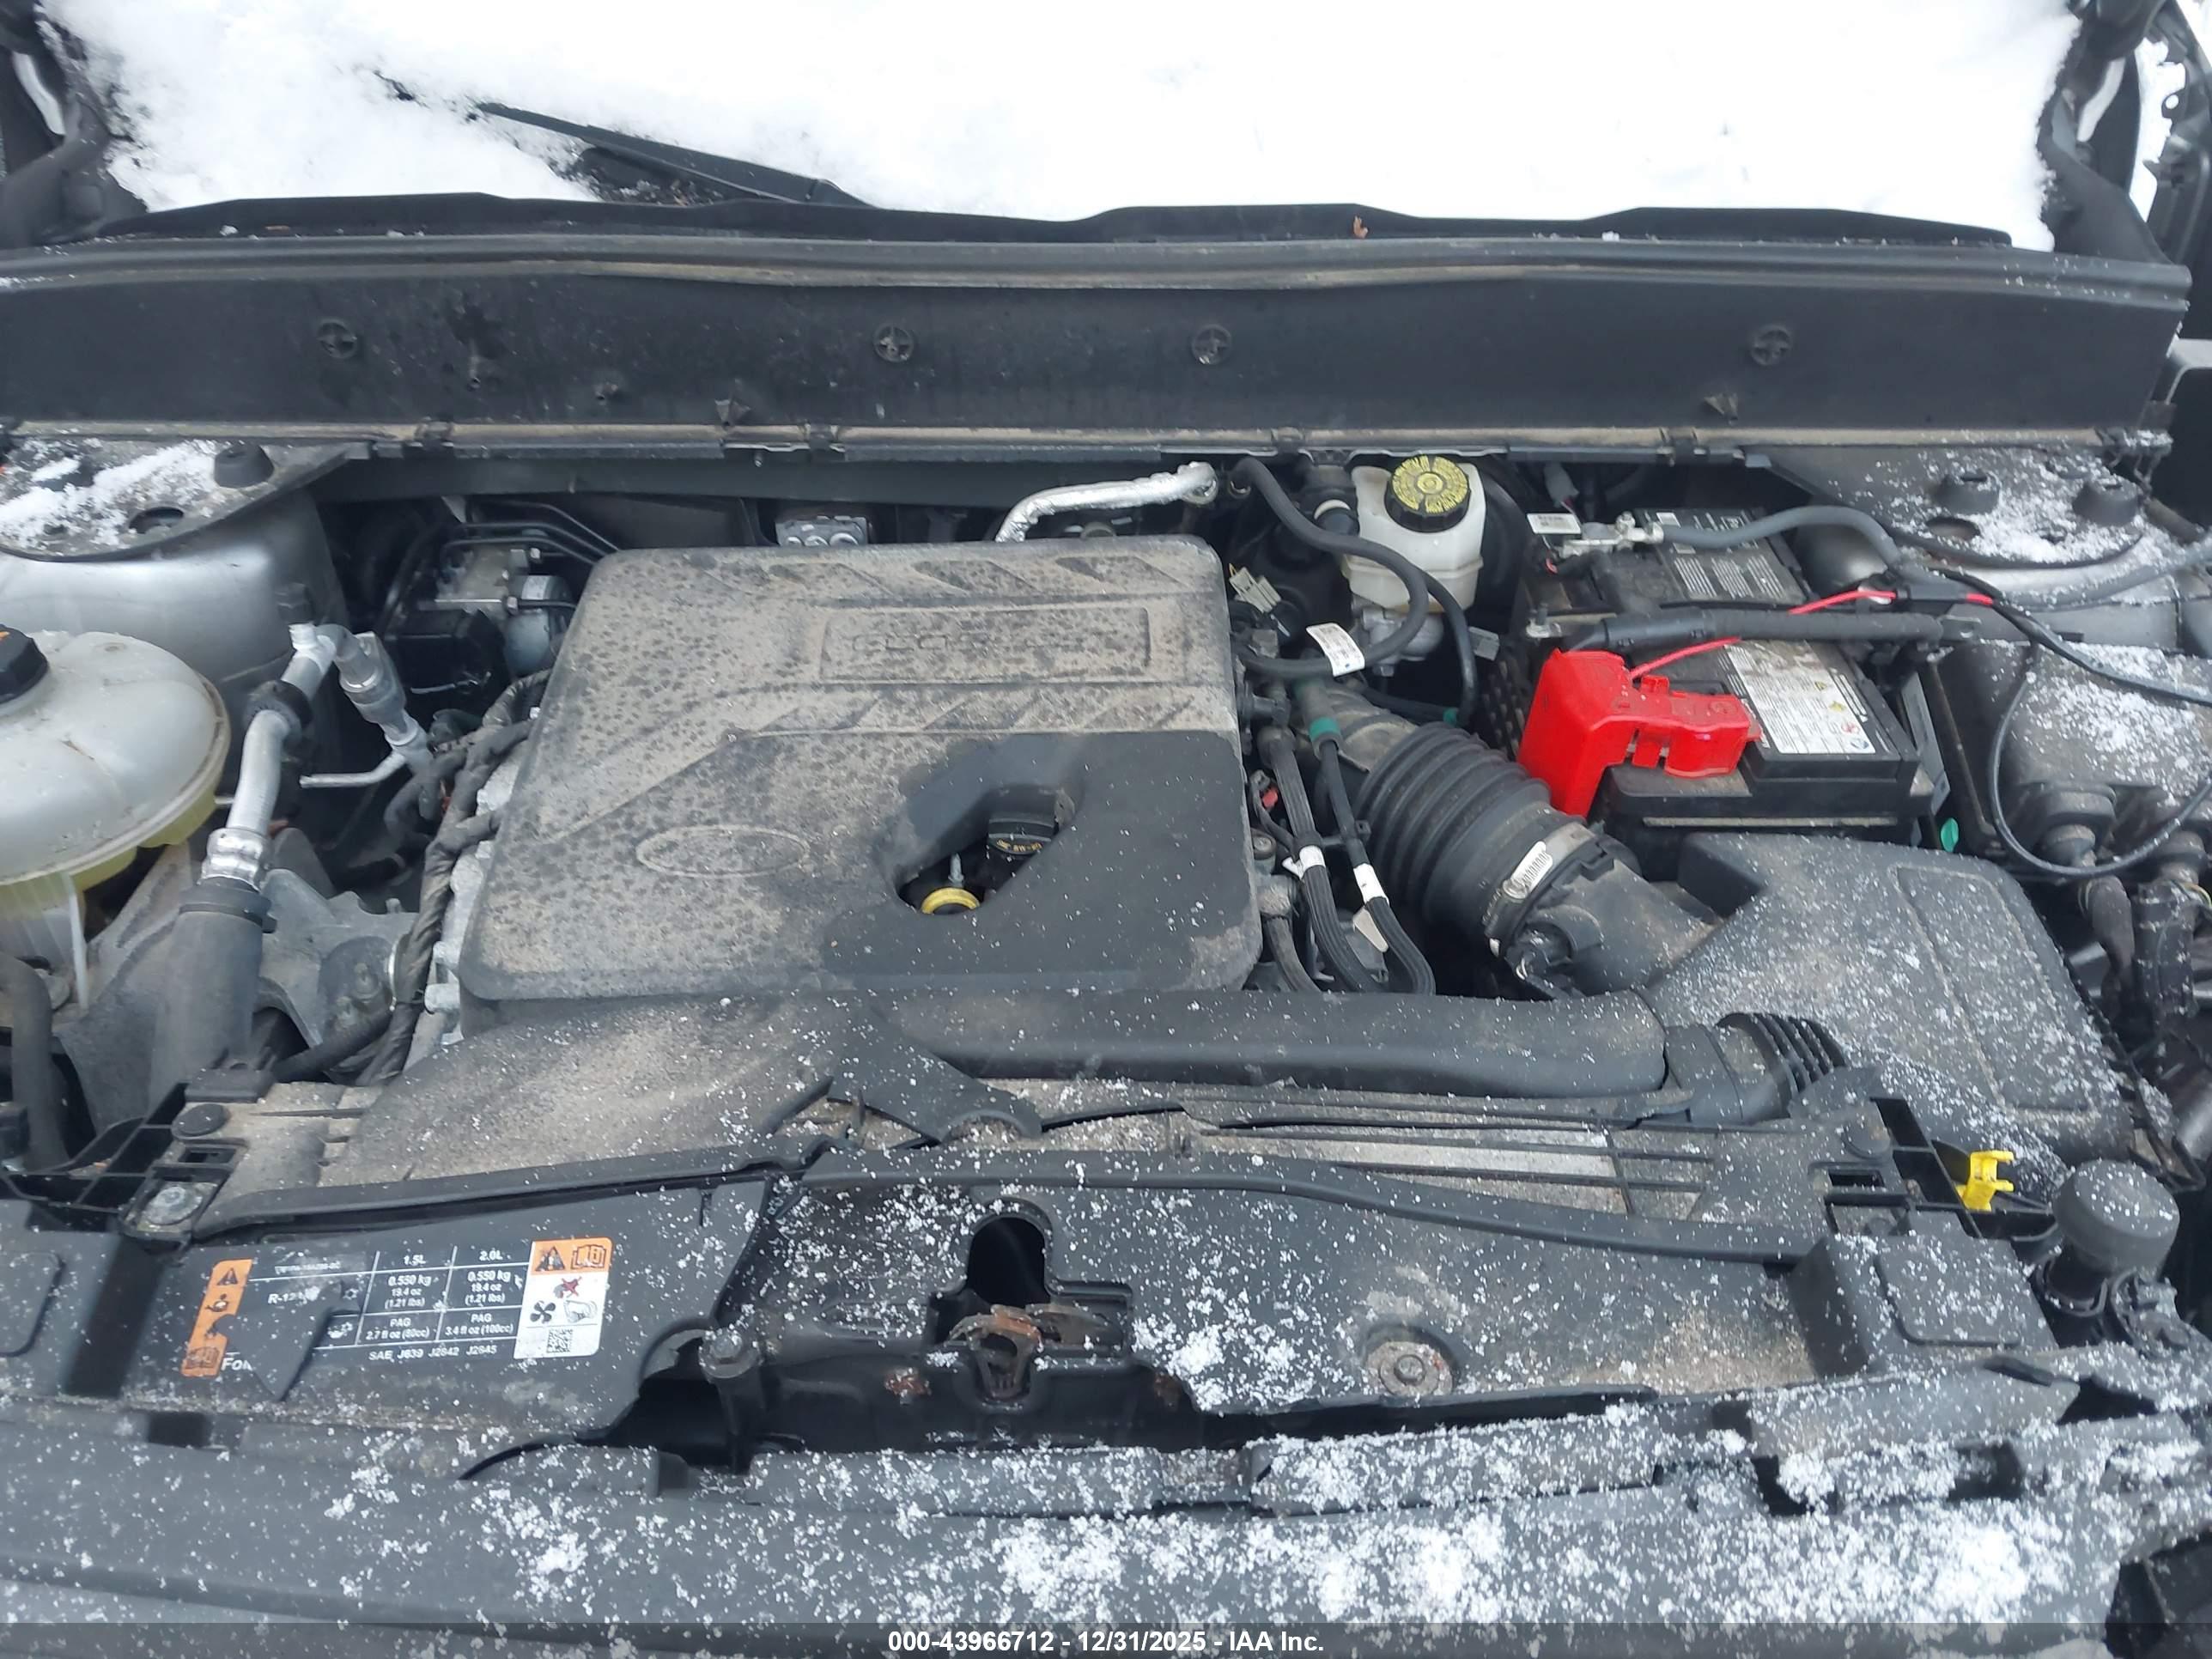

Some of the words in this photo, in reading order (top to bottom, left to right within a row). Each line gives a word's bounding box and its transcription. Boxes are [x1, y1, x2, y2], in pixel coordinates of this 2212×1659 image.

[404, 1255, 427, 1266] 1.5L
[479, 1250, 503, 1261] 2.0L
[417, 1274, 431, 1287] kg
[496, 1269, 511, 1282] kg
[389, 1317, 411, 1327] PAG
[471, 1313, 492, 1323] PAG
